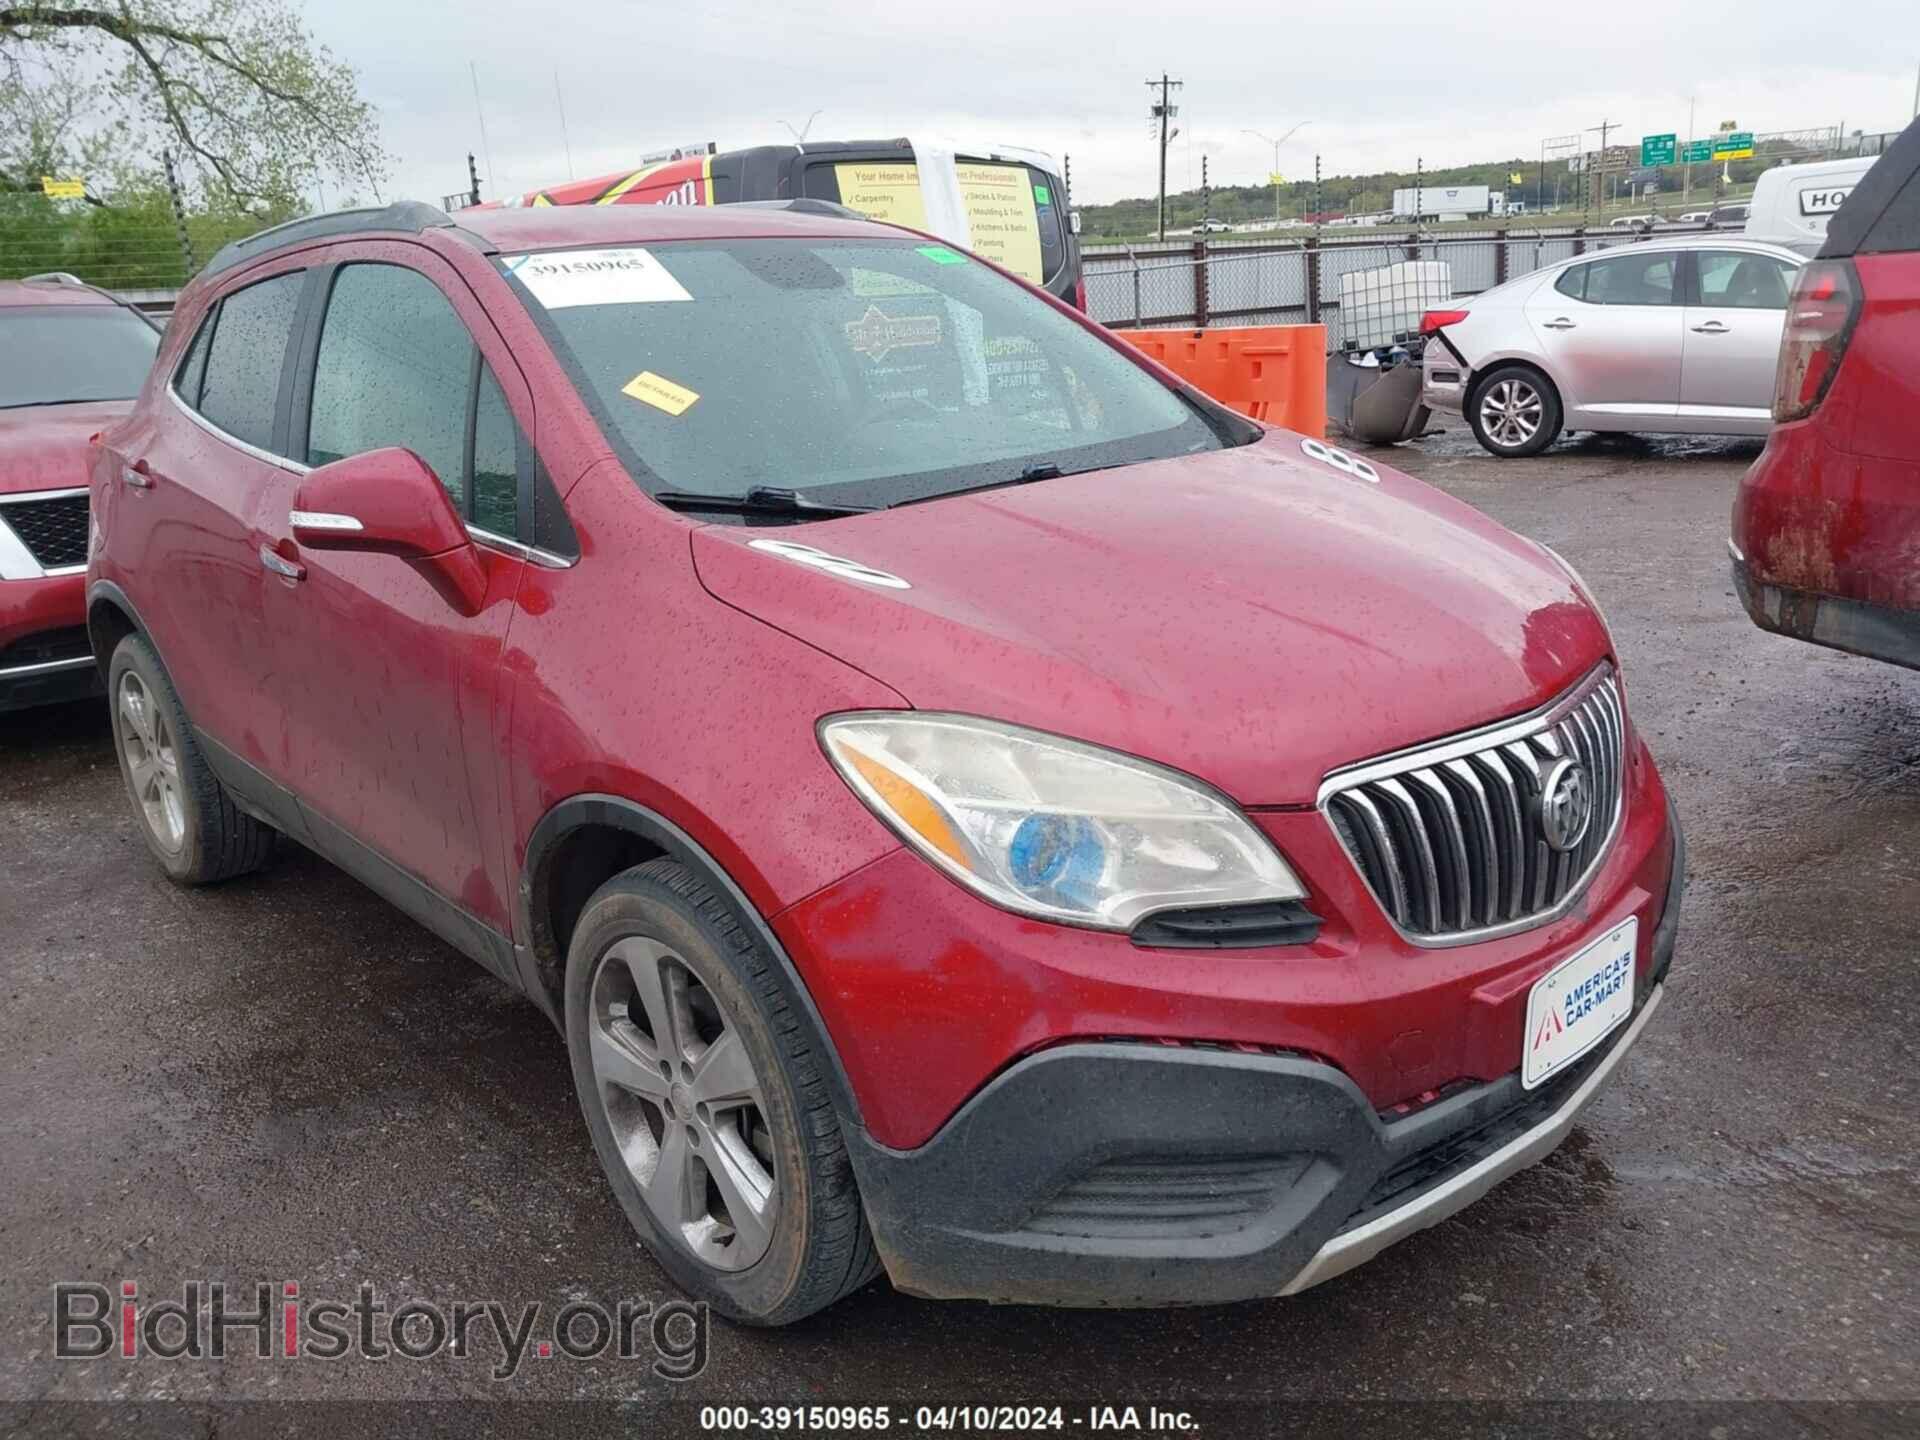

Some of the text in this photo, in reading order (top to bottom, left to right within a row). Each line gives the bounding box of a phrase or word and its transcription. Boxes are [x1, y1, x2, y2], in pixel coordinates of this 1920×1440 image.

[855, 171, 876, 181] Your
[879, 171, 904, 181] Home
[854, 194, 894, 204] Carpentry
[977, 239, 1004, 248] Painting
[528, 258, 645, 277] 39150965
[1564, 952, 1631, 1009] AMERICA'S
[1566, 971, 1628, 1027] CAR-MART
